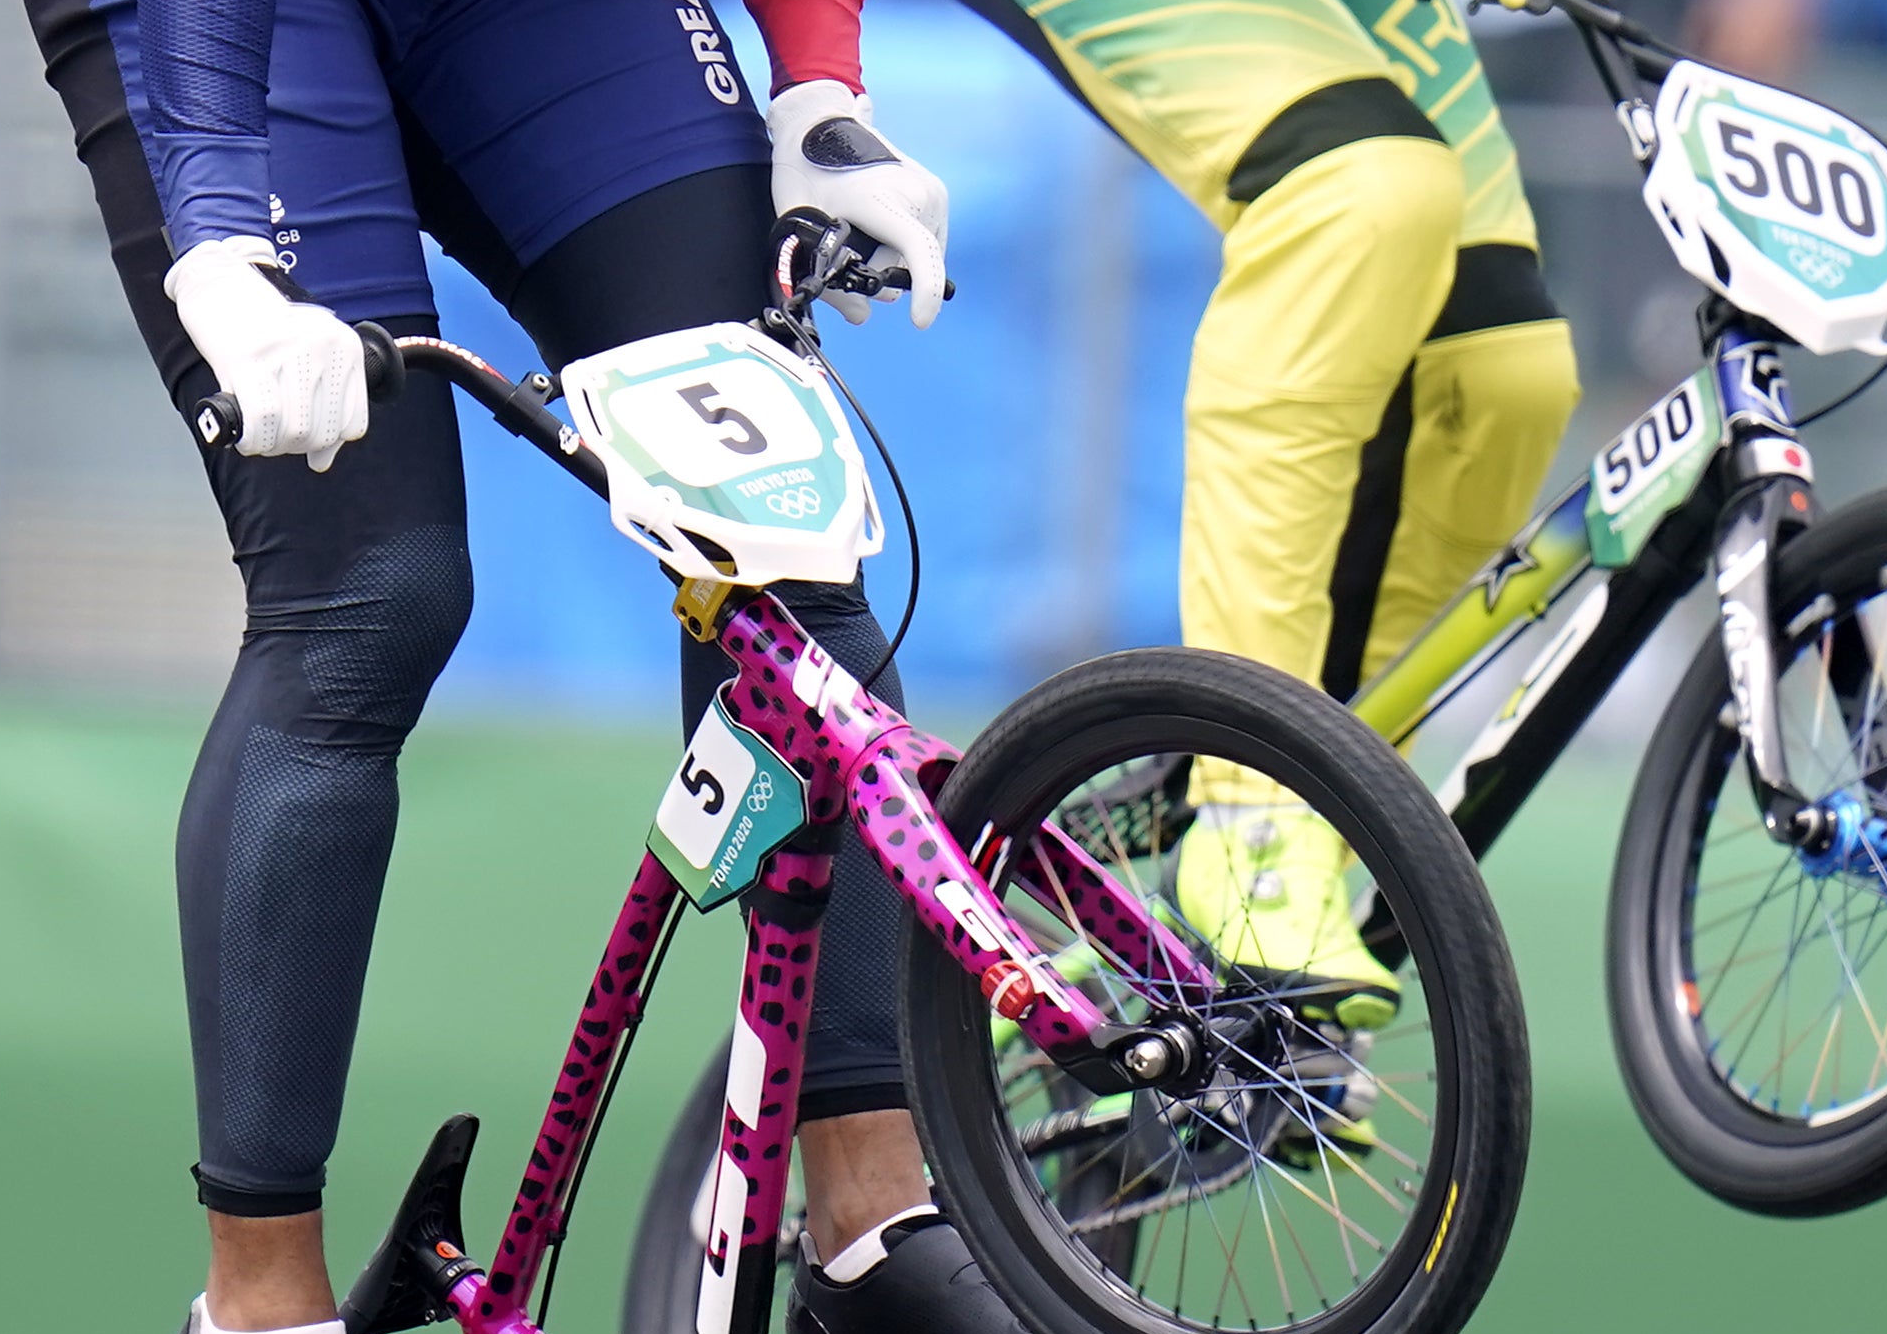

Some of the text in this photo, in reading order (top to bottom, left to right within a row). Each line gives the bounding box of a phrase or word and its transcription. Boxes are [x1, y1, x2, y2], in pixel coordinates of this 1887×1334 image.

[1718, 119, 1875, 237] 500
[275, 229, 301, 245] GB
[676, 382, 768, 455] 5
[1605, 389, 1693, 495] 500
[736, 467, 816, 499] TOKYO 2020
[680, 751, 725, 816] 5
[708, 815, 754, 889] TOKYO 2020
